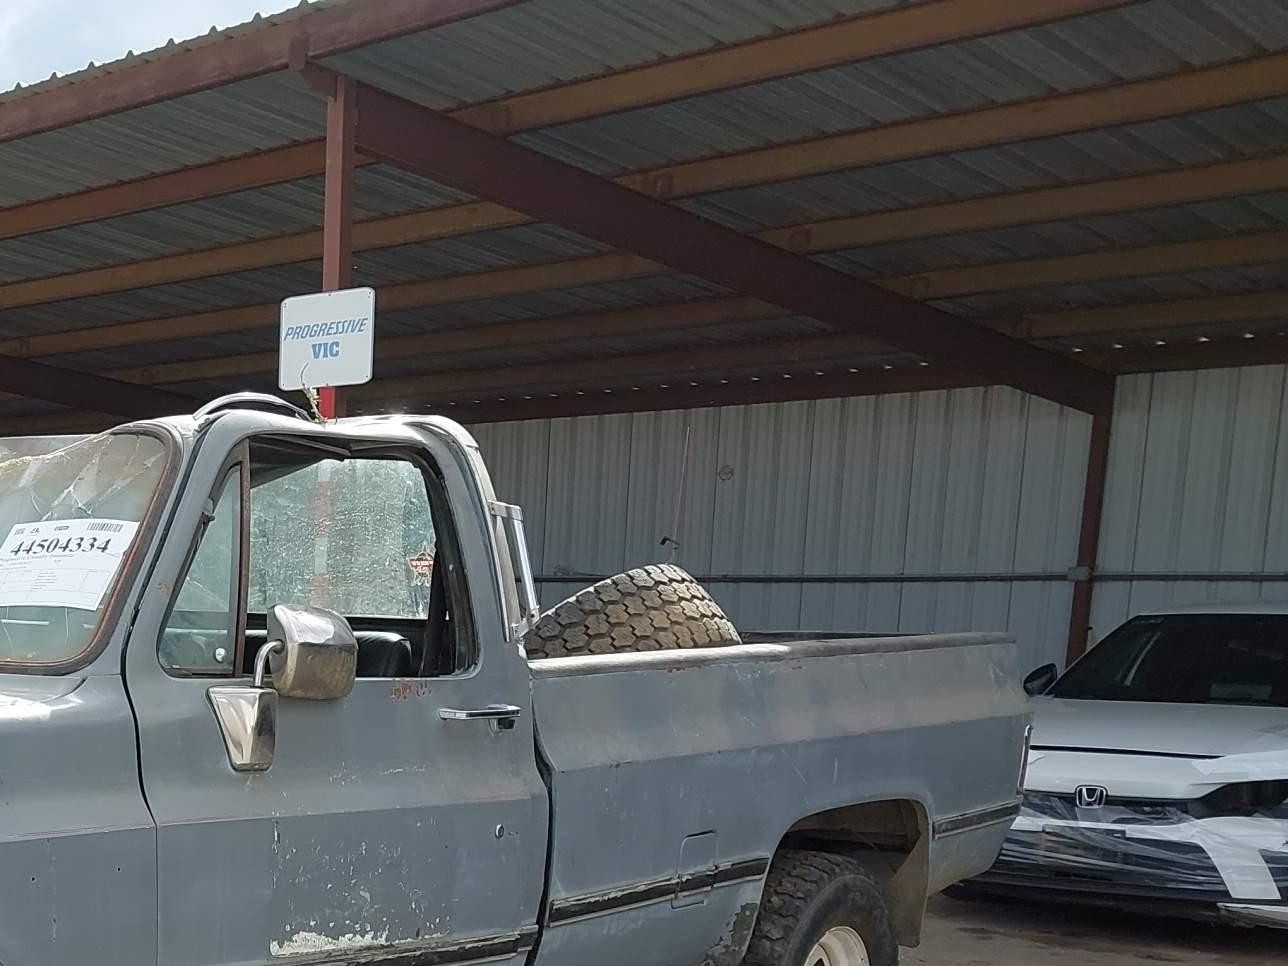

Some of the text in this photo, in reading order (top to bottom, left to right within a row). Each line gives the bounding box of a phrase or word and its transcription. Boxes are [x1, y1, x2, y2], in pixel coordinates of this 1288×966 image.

[284, 318, 368, 341] PROGRESSIVE
[312, 341, 340, 359] VIC
[10, 536, 112, 556] 44504334
